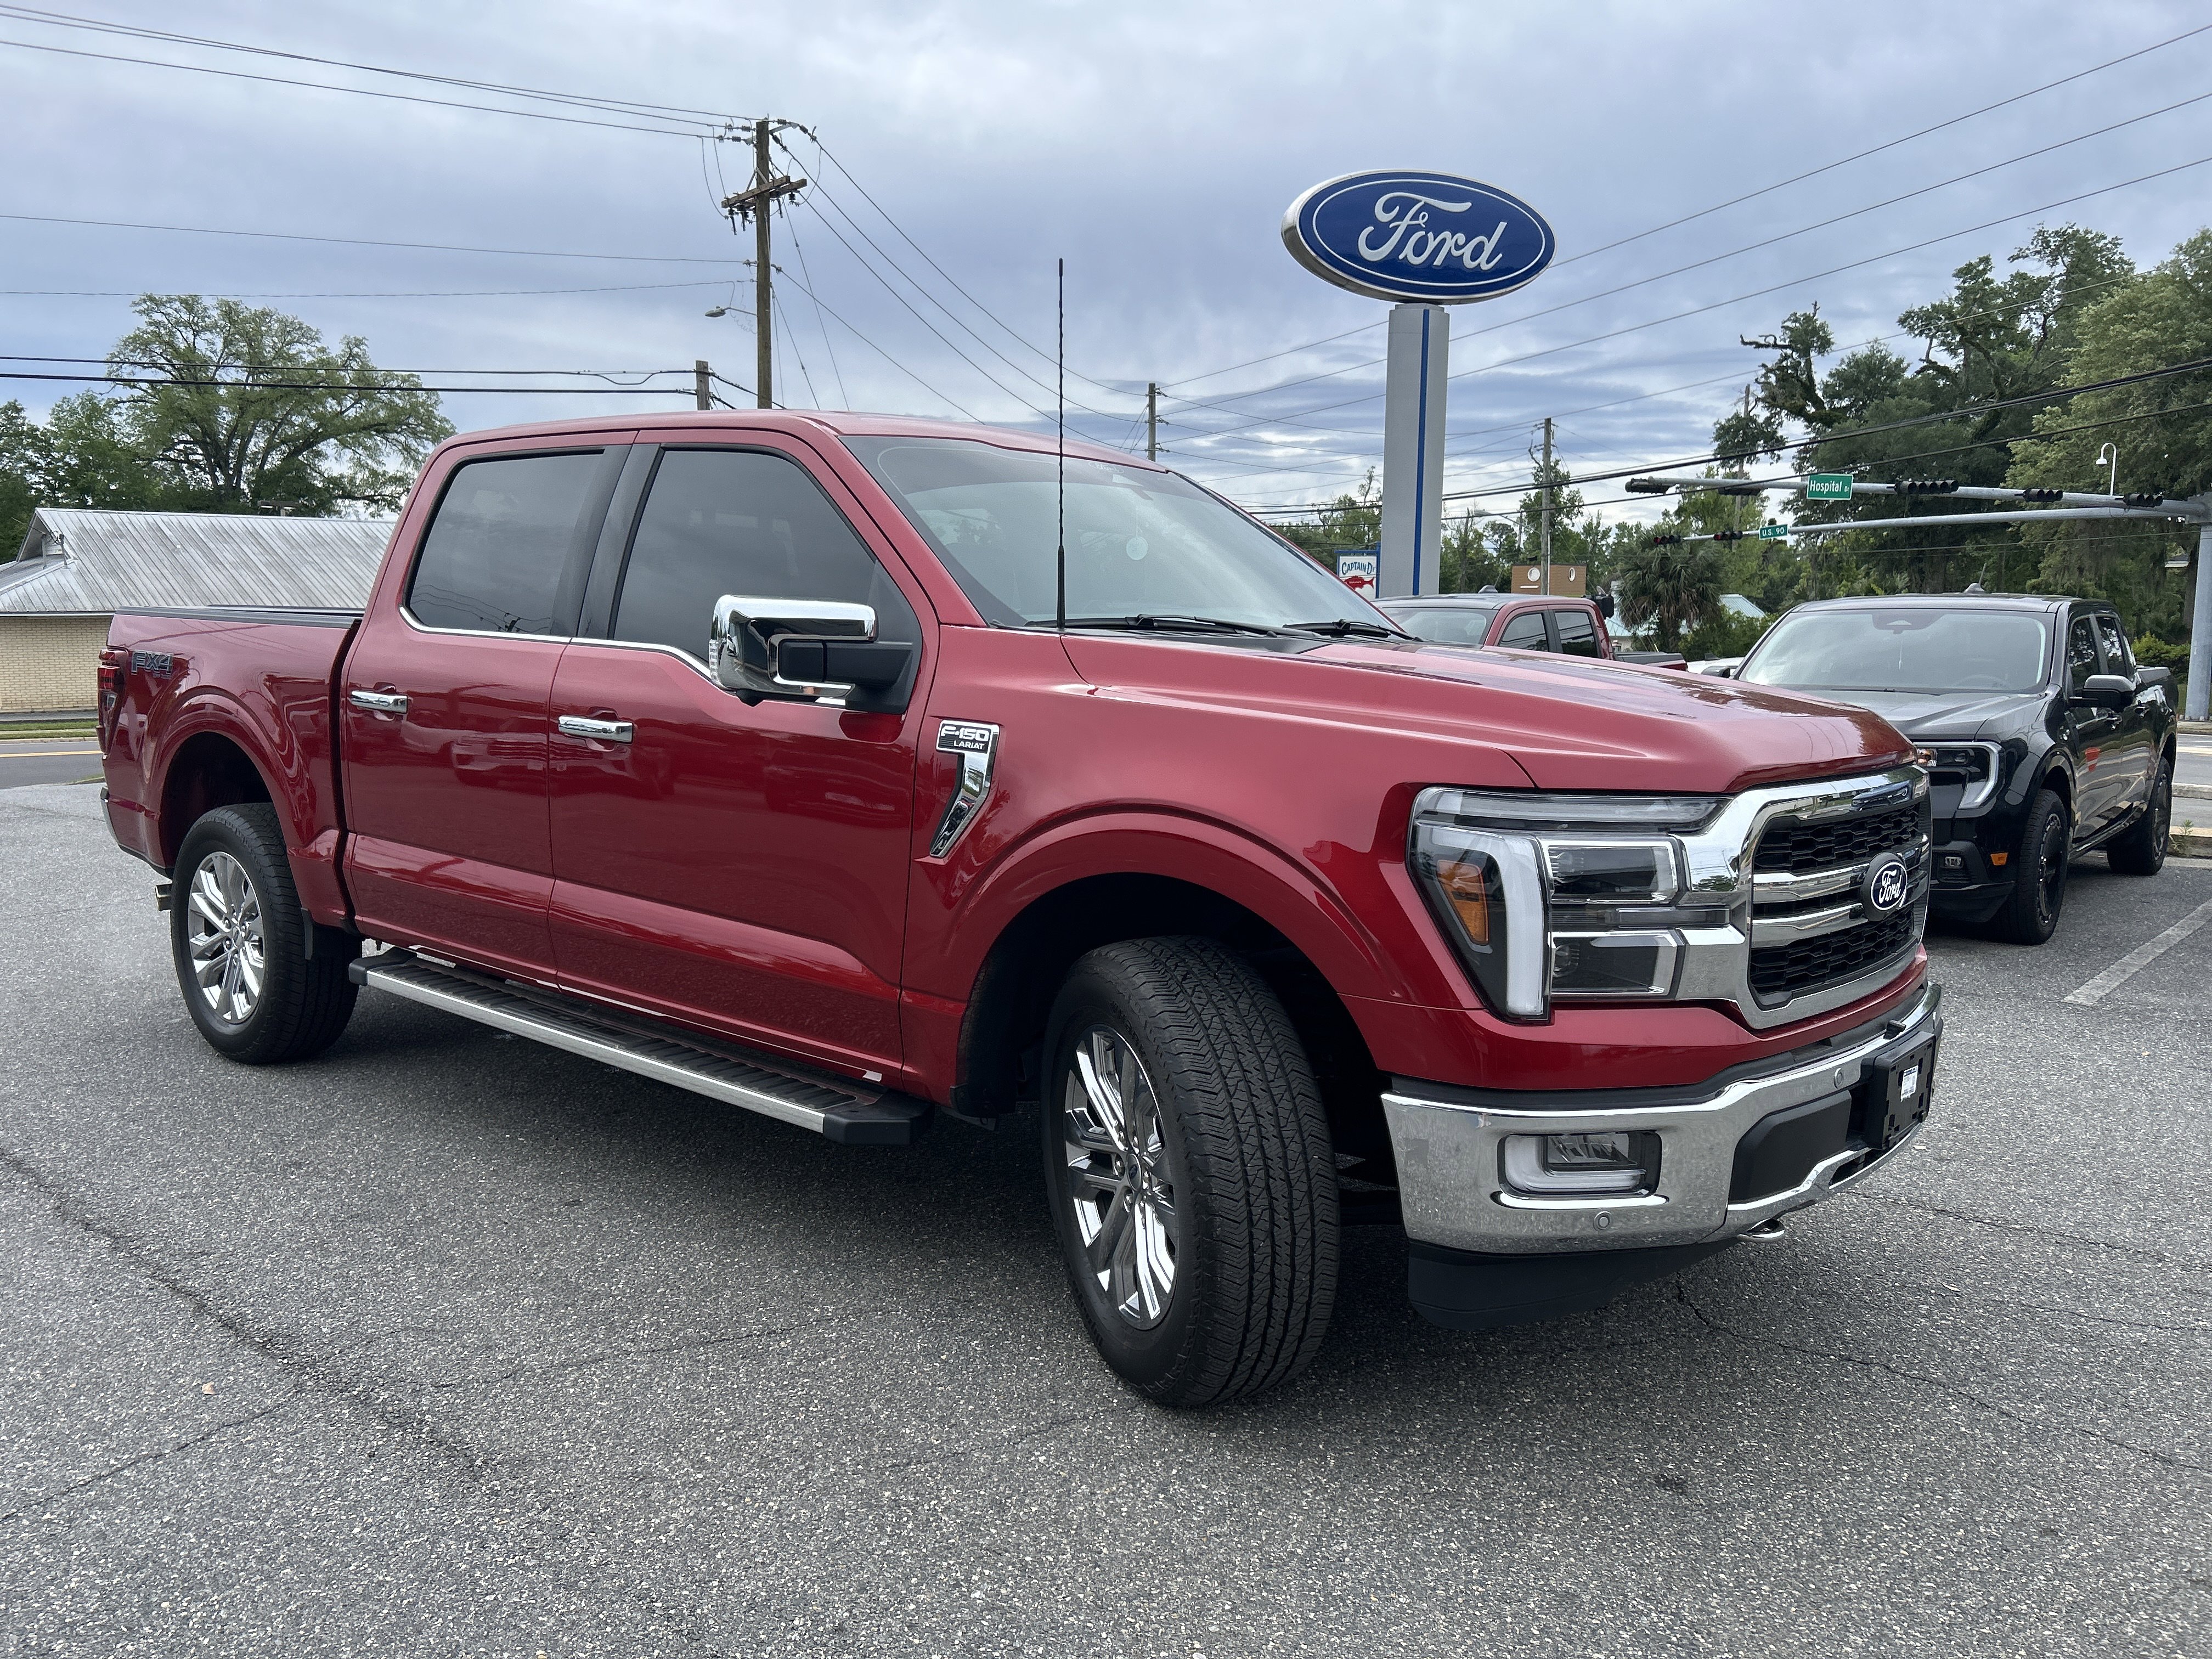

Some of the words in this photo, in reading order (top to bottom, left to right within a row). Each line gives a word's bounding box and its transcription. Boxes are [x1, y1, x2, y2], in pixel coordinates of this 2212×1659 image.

[1358, 192, 1508, 270] Ford
[1810, 480, 1842, 494] Hospital
[1341, 562, 1367, 575] CAPTAIN
[131, 650, 174, 675] FX4
[940, 725, 990, 742] F-150
[953, 741, 985, 749] LARIAT
[1878, 869, 1903, 904] Ford
